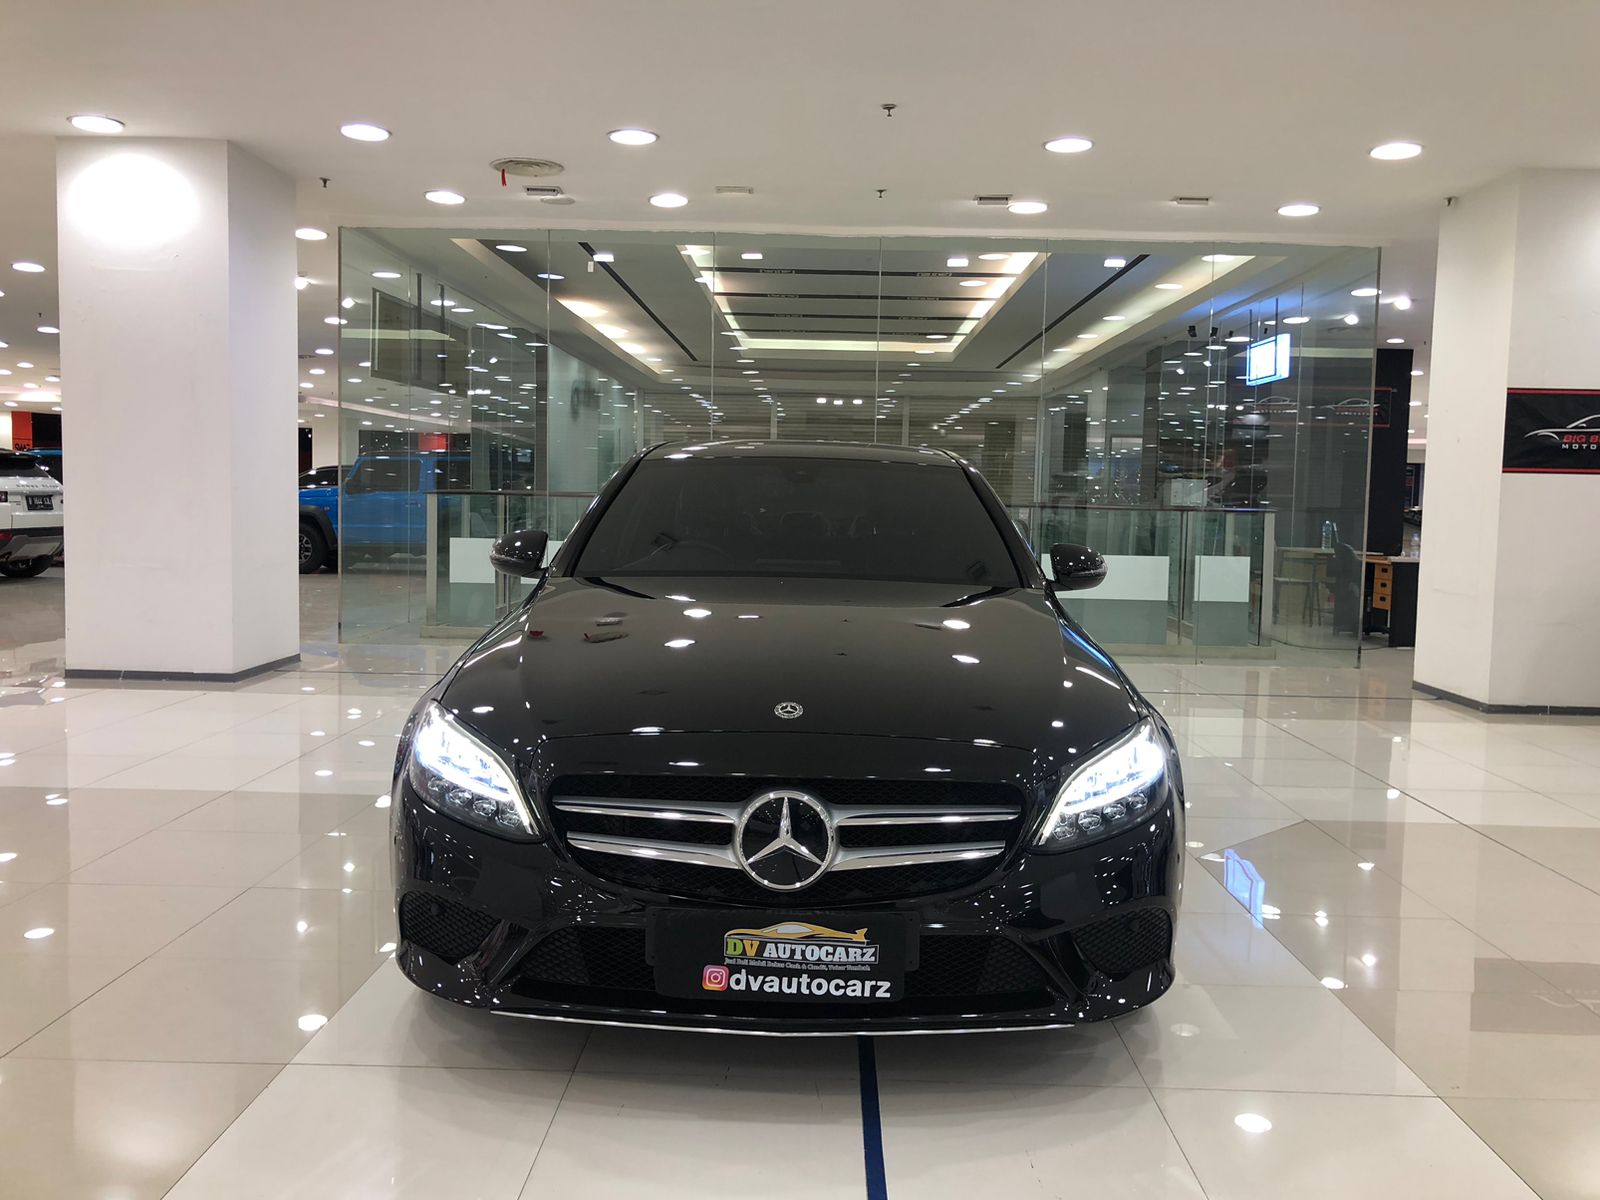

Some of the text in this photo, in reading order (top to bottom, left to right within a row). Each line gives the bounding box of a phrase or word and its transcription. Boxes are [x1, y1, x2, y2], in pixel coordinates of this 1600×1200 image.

[726, 938, 876, 962] DV AUTOCARZ
[729, 969, 892, 998] dvautocarz
